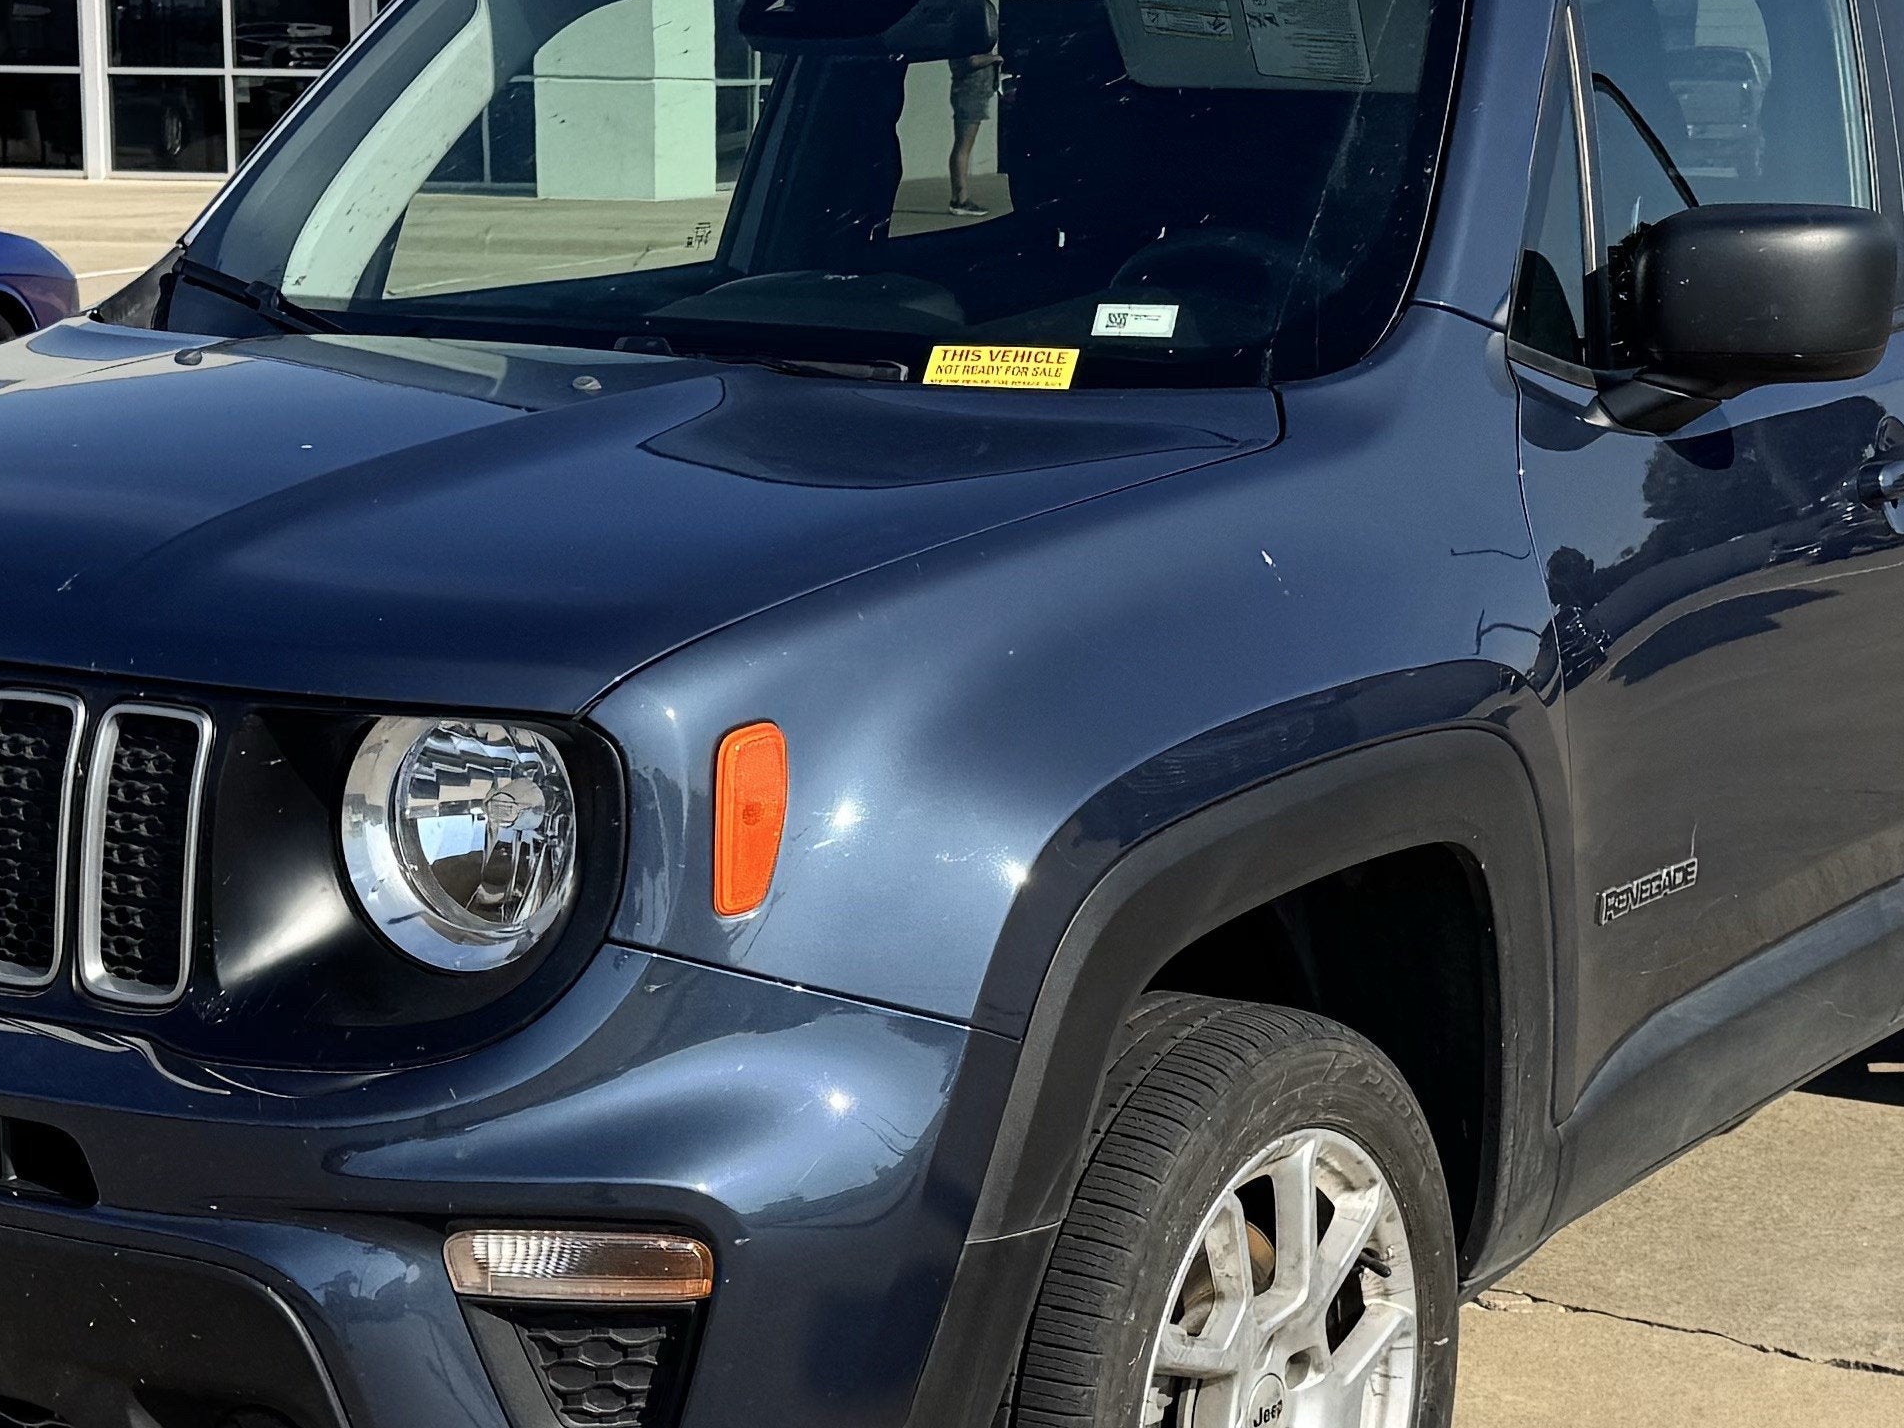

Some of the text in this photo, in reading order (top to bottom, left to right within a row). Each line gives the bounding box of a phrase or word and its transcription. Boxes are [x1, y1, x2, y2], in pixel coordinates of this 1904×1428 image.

[941, 349, 1069, 364] THIS VEHICLE
[935, 364, 1063, 378] NOT READY FOR SALE
[1596, 857, 1698, 926] RENEGADE
[1253, 1399, 1283, 1428] Jeep
